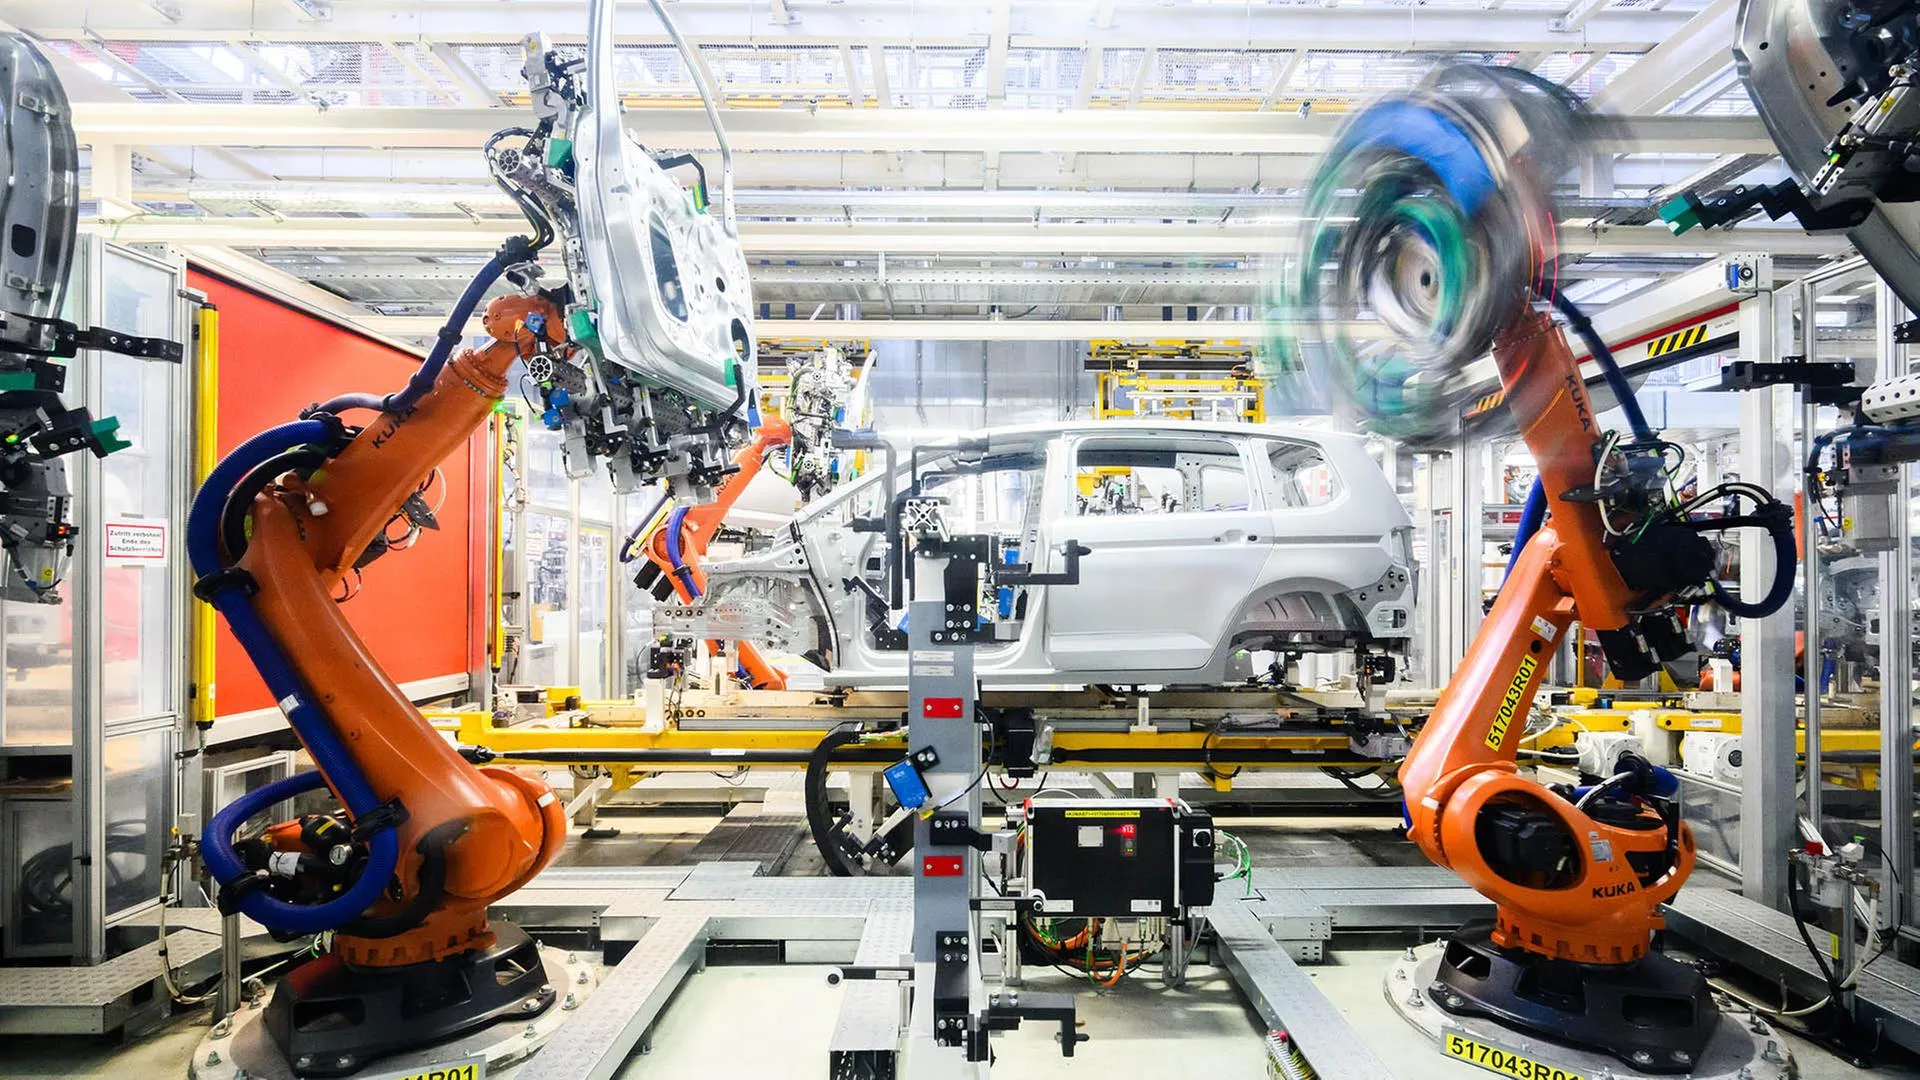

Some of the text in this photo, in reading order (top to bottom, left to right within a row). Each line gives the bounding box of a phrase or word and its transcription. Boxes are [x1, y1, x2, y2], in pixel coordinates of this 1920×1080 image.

[1566, 375, 1591, 432] KUKA
[372, 407, 417, 448] KUKA
[1488, 658, 1536, 747] 517043R01
[1592, 881, 1635, 898] KUKA
[1452, 1036, 1579, 1080] 517043R0
